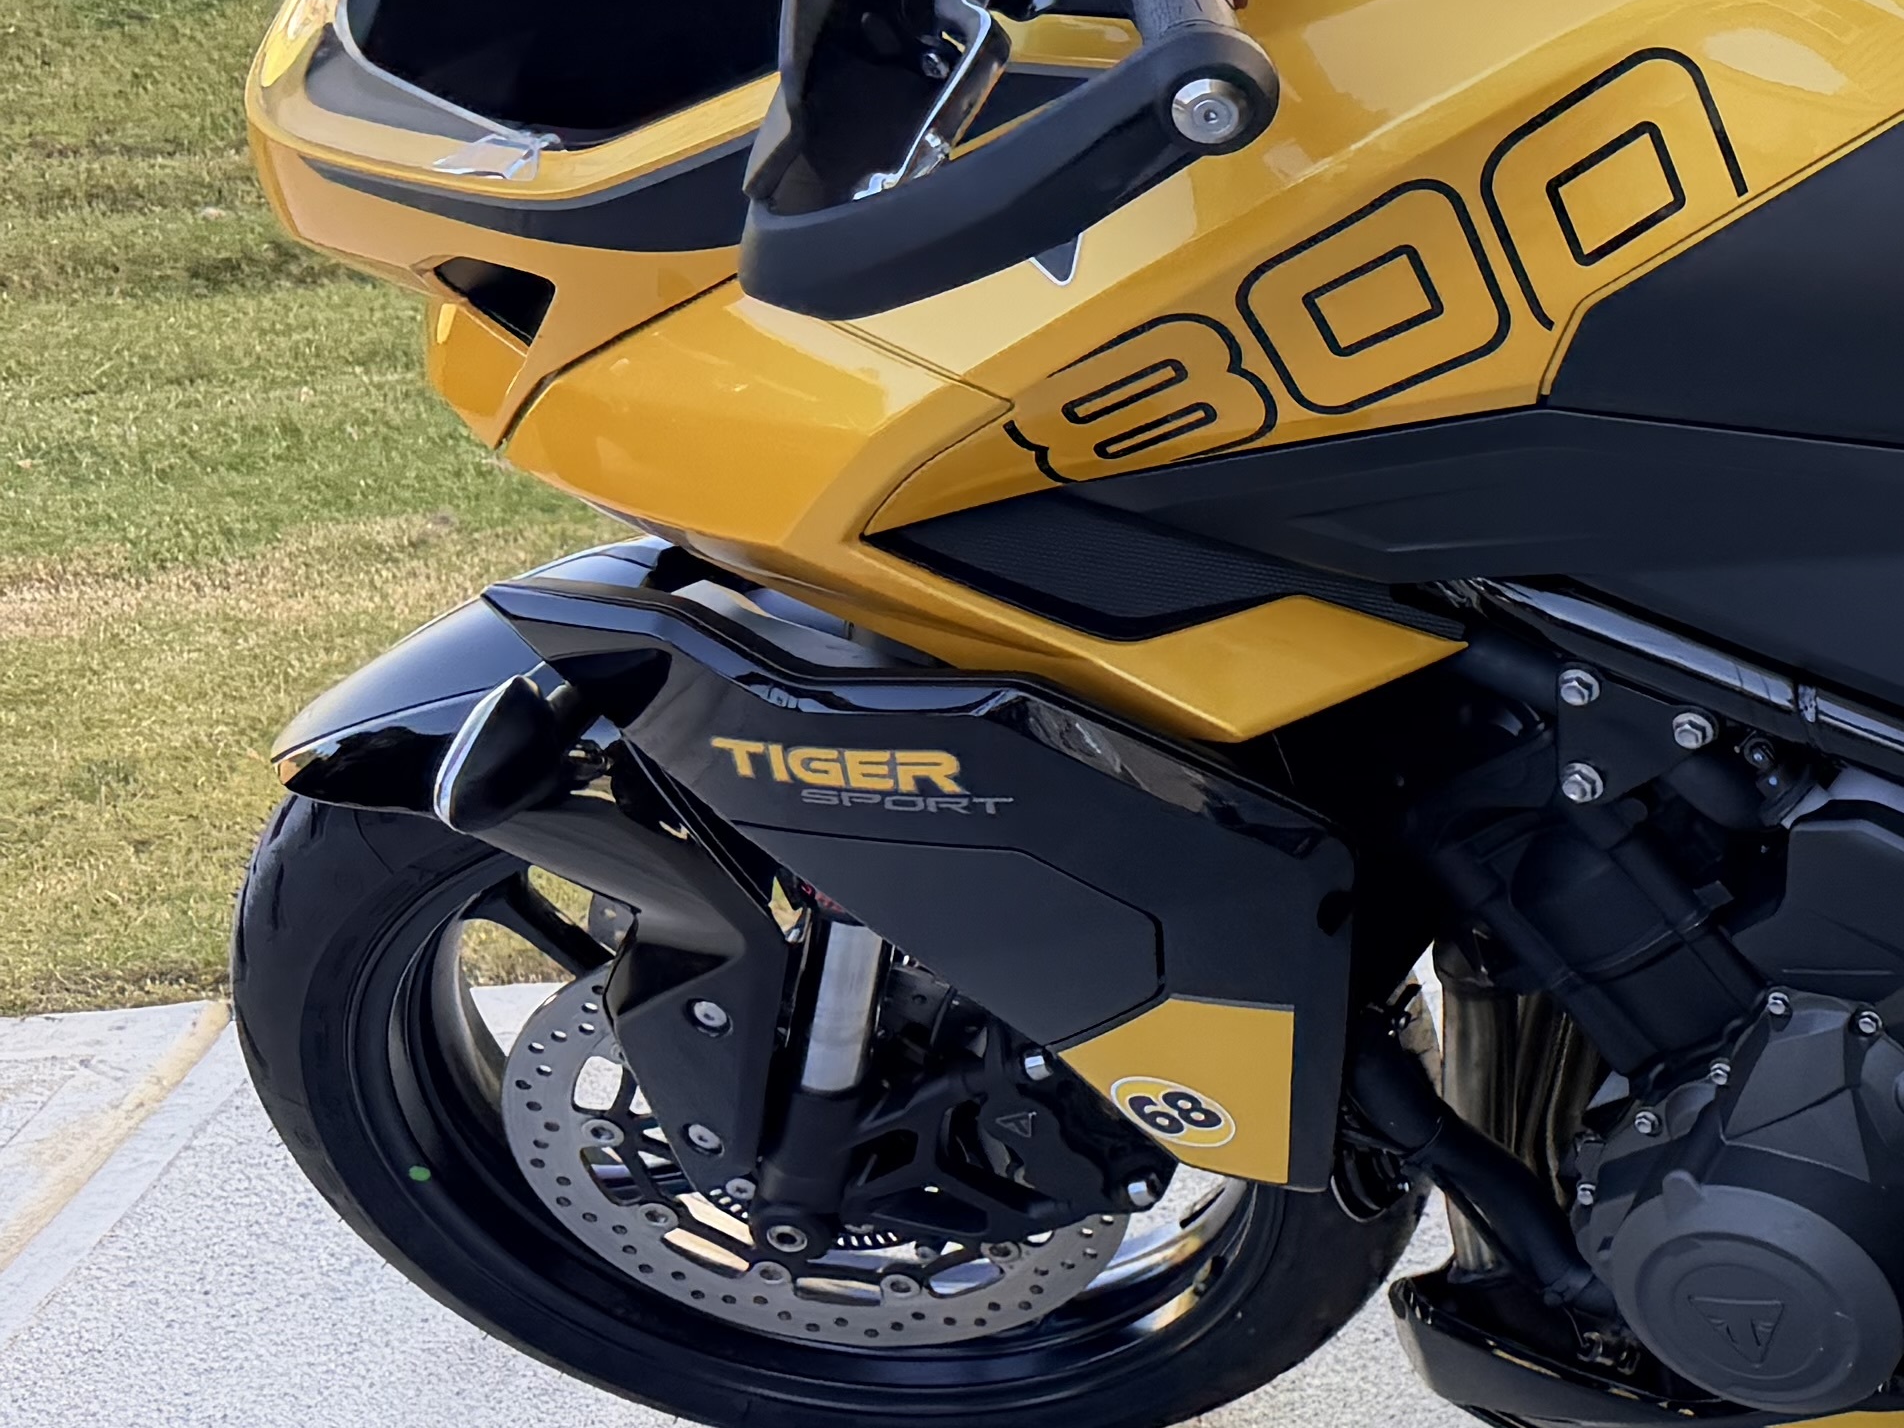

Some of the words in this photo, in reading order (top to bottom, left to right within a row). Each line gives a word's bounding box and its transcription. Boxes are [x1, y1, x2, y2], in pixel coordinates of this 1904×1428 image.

[1004, 46, 1749, 485] 800
[710, 736, 966, 795] TIGER
[800, 788, 1014, 815] SPORT
[1128, 1090, 1223, 1135] 68
